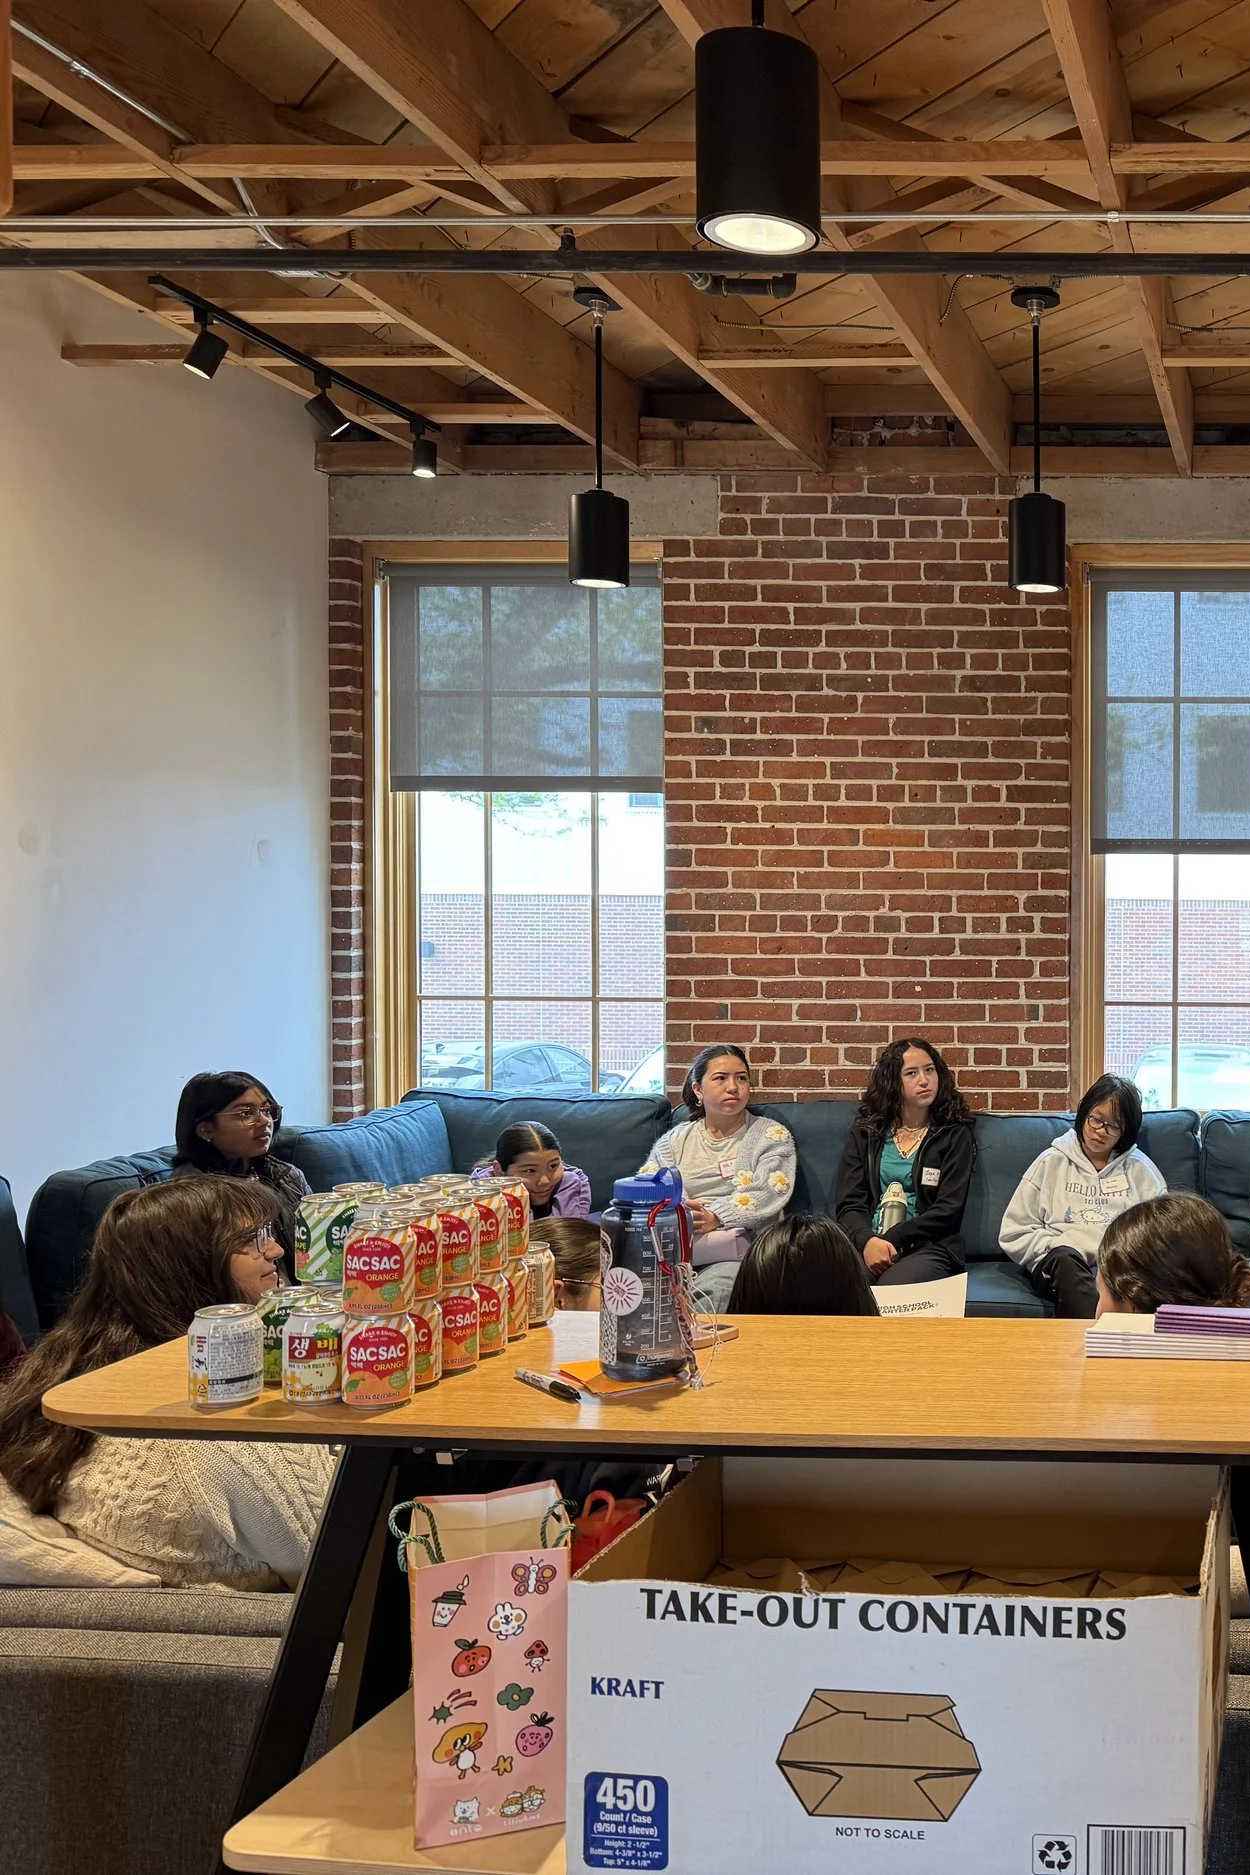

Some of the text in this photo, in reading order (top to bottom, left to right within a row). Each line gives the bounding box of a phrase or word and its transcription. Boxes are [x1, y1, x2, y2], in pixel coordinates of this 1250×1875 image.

[1065, 1182, 1097, 1197] HELLO
[366, 1273, 400, 1281] ORANGE
[896, 1301, 934, 1309] SCHOOL
[911, 1304, 935, 1312] PACK
[373, 1361, 405, 1371] ORANGE
[640, 1588, 1127, 1640] TAKE-OUT CONTAINERS
[590, 1676, 665, 1700] KRAFT
[596, 1777, 656, 1813] 450
[600, 1811, 624, 1822] Count
[631, 1813, 652, 1824] Case
[593, 1822, 658, 1837] (9/50 ct sleeve)
[835, 1827, 925, 1840] NOT TO SCALE
[604, 1839, 626, 1849] Height:
[589, 1847, 613, 1856] Bottom:
[603, 1857, 615, 1866] Top:
